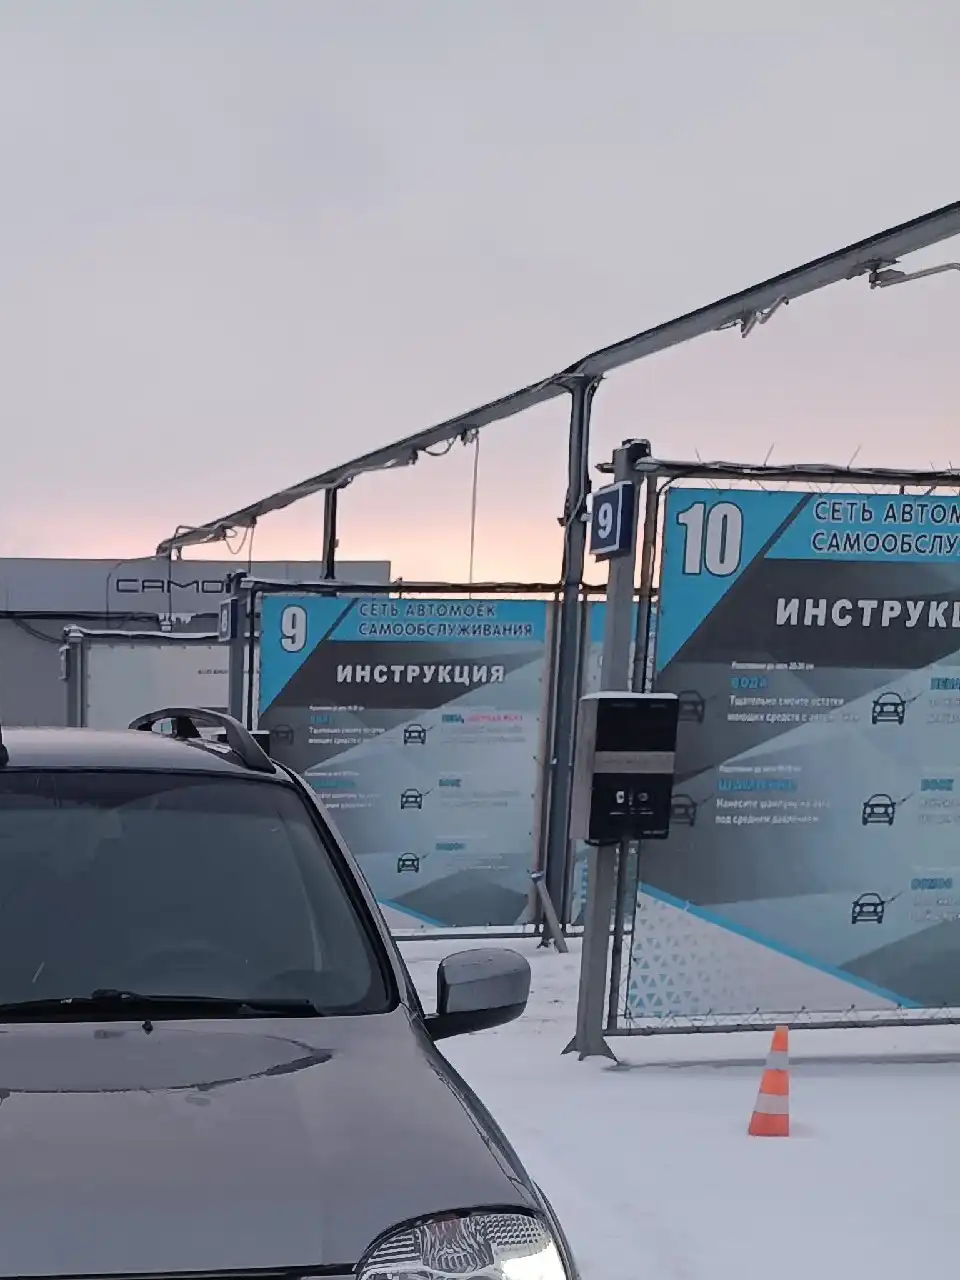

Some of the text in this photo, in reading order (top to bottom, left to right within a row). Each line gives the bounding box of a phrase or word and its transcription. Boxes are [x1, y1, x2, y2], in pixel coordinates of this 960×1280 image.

[597, 502, 613, 539] 9
[815, 501, 874, 521] СЕТЬ
[677, 500, 744, 577] 10
[359, 602, 399, 617] СЕТЬ
[281, 605, 308, 652] 9
[358, 622, 533, 637] САМООБСЛУЖИВАНИЯ
[336, 664, 506, 686] ИНСТРУКЦИЯ
